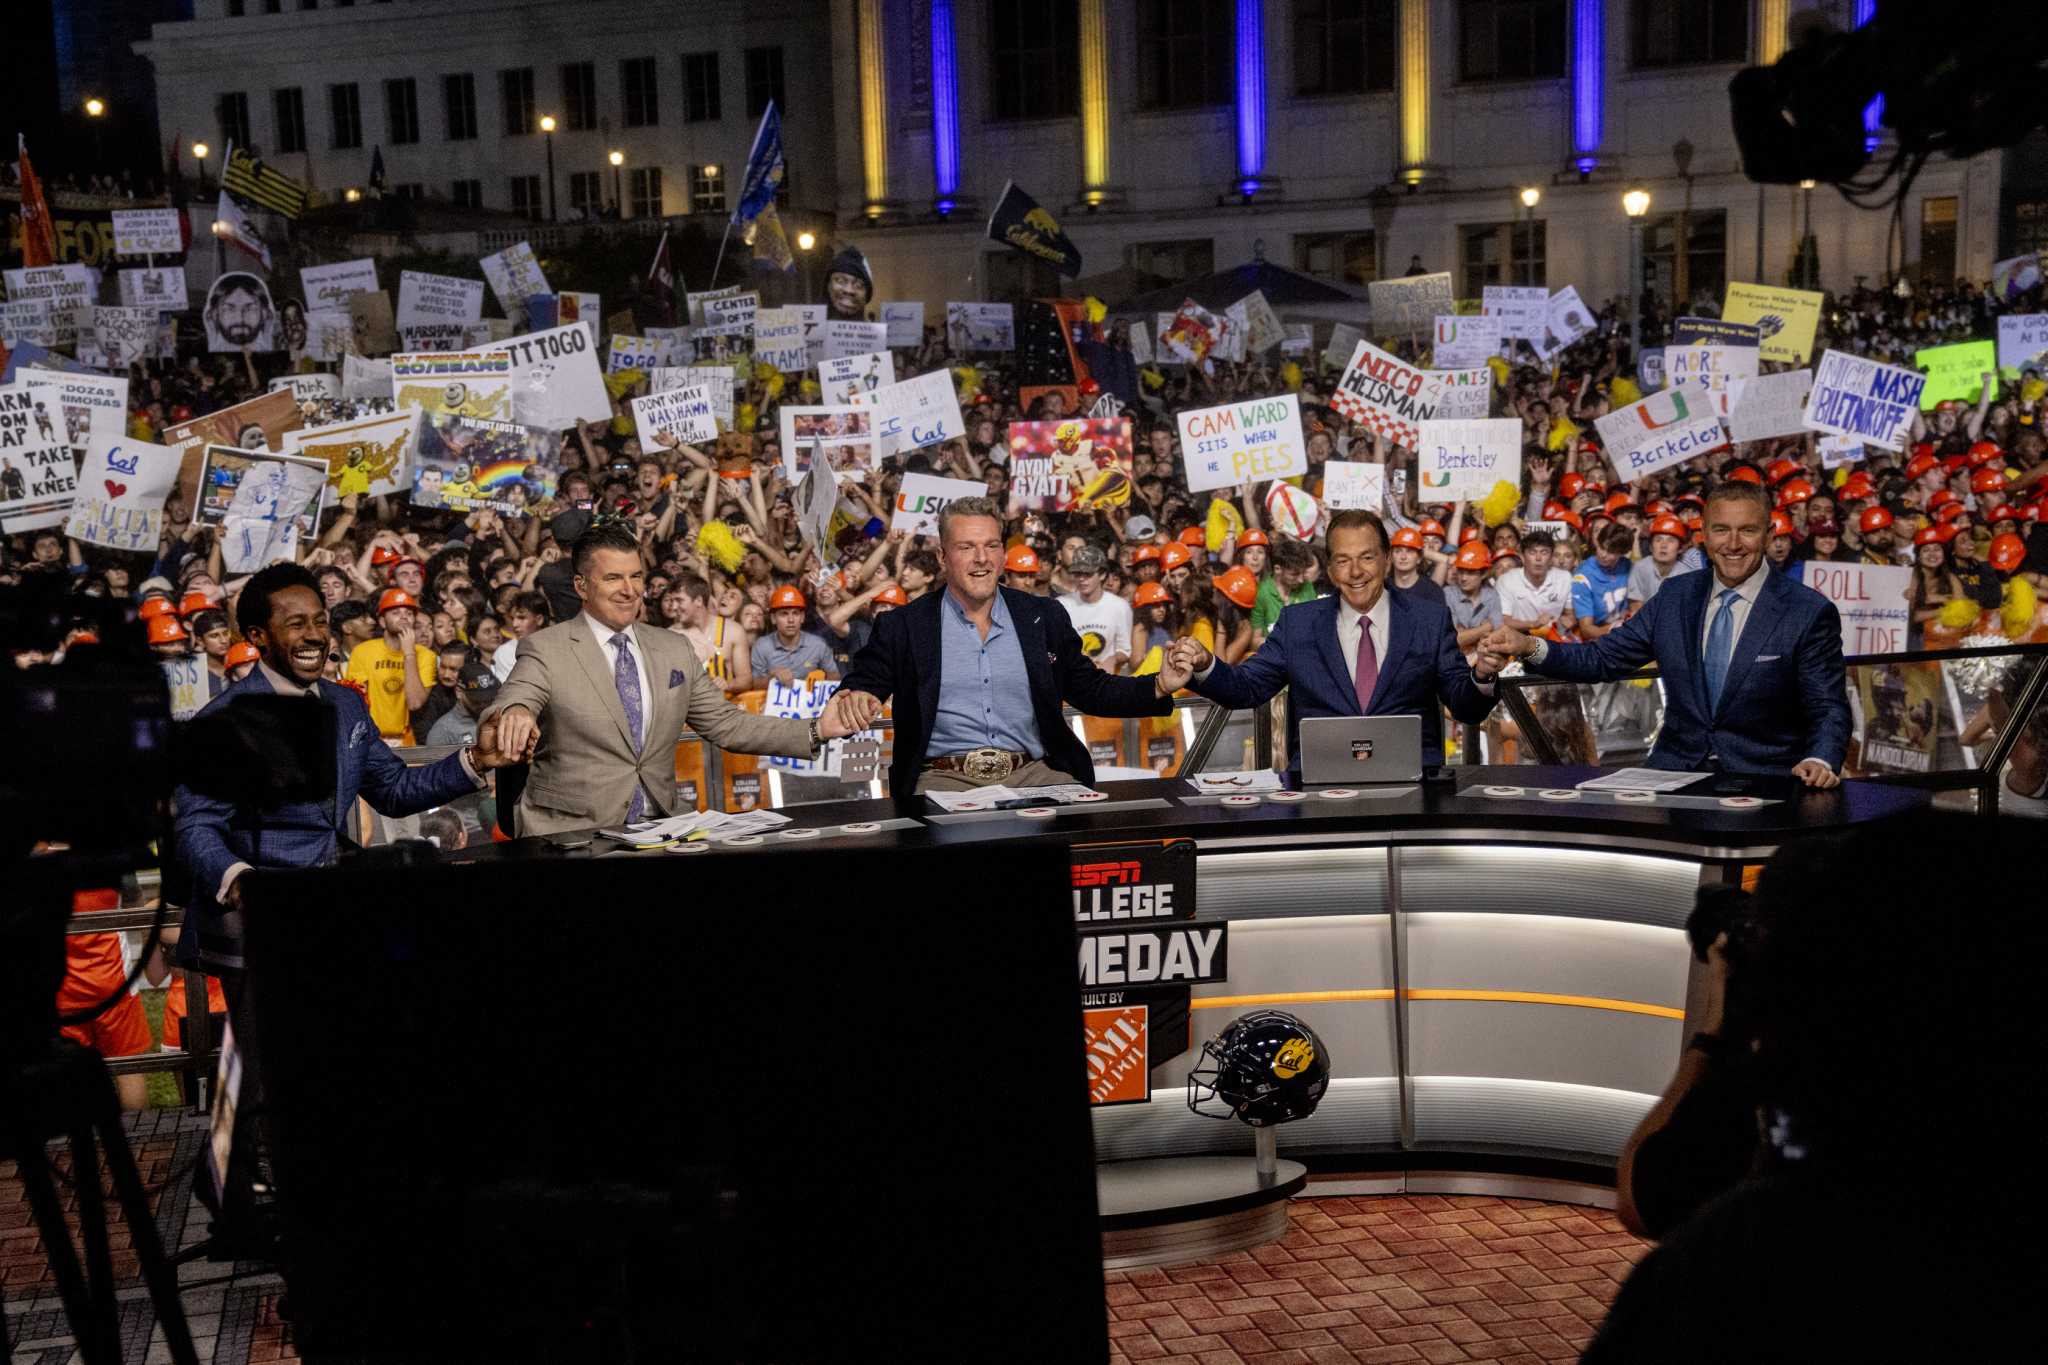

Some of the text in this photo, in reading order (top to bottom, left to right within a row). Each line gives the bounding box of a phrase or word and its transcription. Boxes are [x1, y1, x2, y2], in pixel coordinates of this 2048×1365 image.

[24, 270, 65, 284] GETTING
[424, 274, 456, 286] STANDS
[9, 284, 53, 300] MARRIED
[420, 295, 464, 308] AFFECTED
[95, 308, 155, 319] EVEN THE
[713, 297, 756, 311] CENTER
[727, 311, 755, 323] OF TH
[404, 324, 463, 339] MARSHAWN
[757, 324, 800, 338] LAWYERS
[534, 329, 586, 360] TOGO
[612, 352, 656, 368] TOGO
[832, 359, 853, 368] TASTE
[1674, 350, 1725, 372] MORE
[828, 373, 861, 382] RAINBOW
[1356, 351, 1424, 397] NICO
[1819, 352, 1875, 396] NICK
[1868, 367, 1926, 407] NASH
[1344, 370, 1436, 422] HEISMAN
[1457, 389, 1487, 402] CAUSE
[647, 400, 709, 426] MARSHAWN
[1187, 401, 1289, 439] CAM WARD
[460, 416, 475, 428] YOU
[496, 421, 515, 433] LOST
[515, 424, 526, 435] TO
[911, 420, 946, 448] Cal
[1198, 430, 1277, 453] SITS WHEN
[1629, 424, 1719, 469] Berkeley
[24, 445, 73, 467] TAKE
[106, 446, 140, 476] Cal
[1207, 443, 1293, 480] HE PEES
[1437, 444, 1498, 470] Berkeley
[44, 466, 57, 480] A
[32, 477, 77, 497] KNEE
[1013, 473, 1070, 497] GYATT
[1814, 567, 1871, 601] ROLL
[1109, 991, 1125, 1005] BY
[1277, 1050, 1302, 1071] Cal
